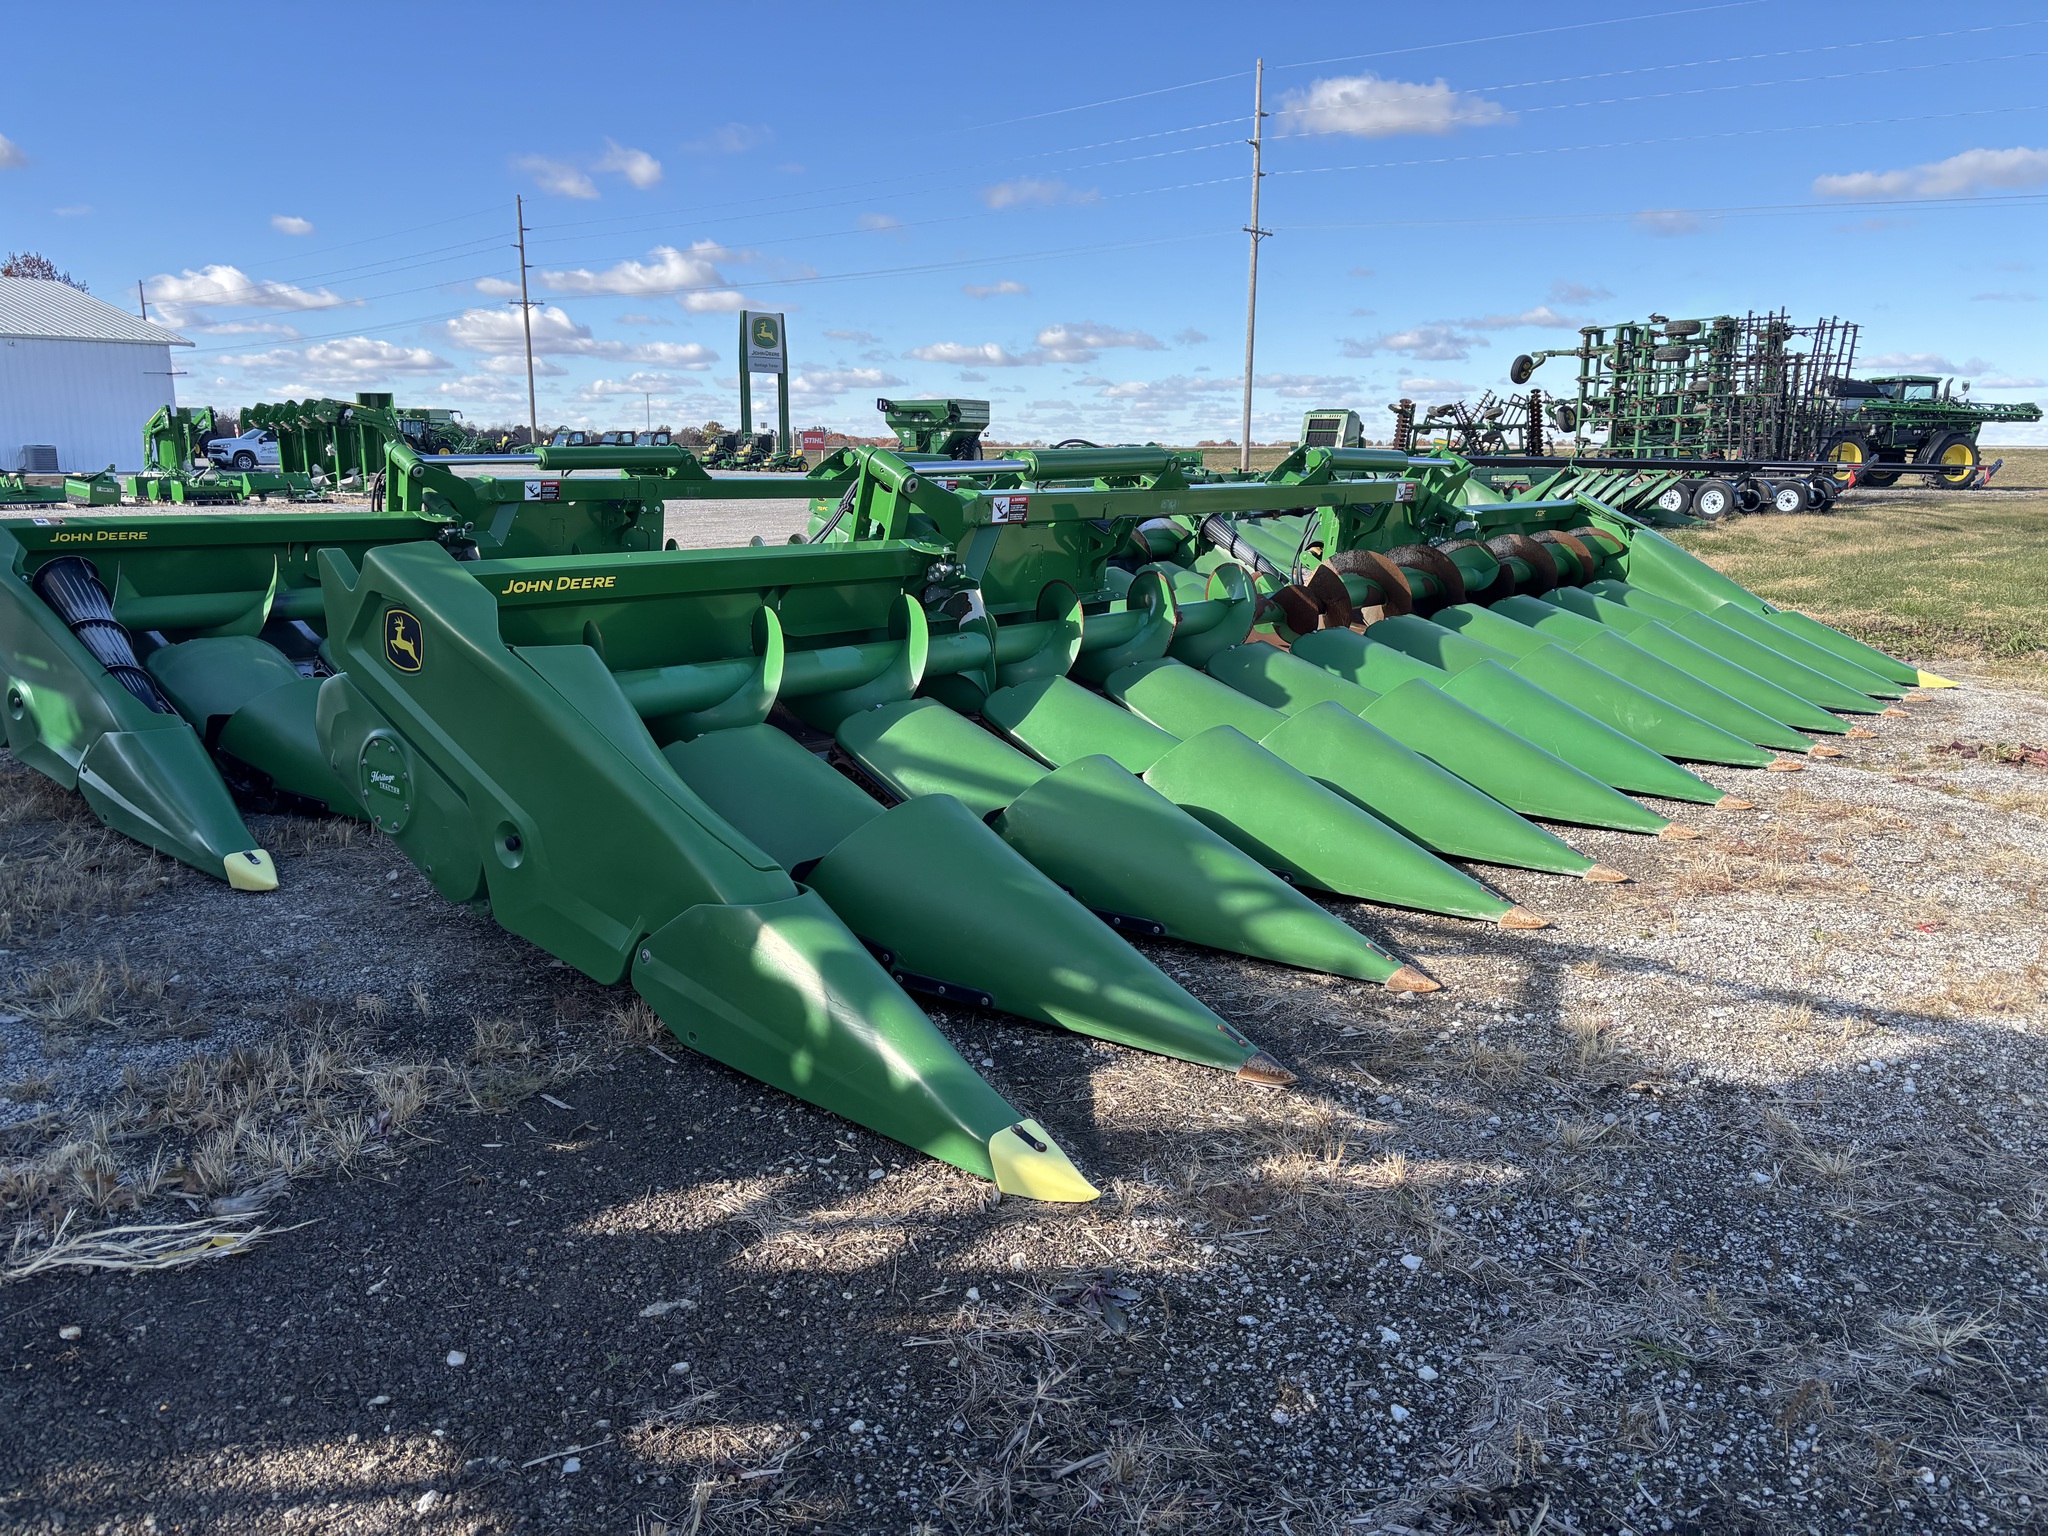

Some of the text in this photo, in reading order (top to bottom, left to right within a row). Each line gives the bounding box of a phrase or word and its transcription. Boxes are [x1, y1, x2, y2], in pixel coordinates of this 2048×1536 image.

[50, 531, 148, 542] JOHN DEERE
[501, 576, 616, 594] JOHN DEERE
[371, 771, 395, 783] Heritage
